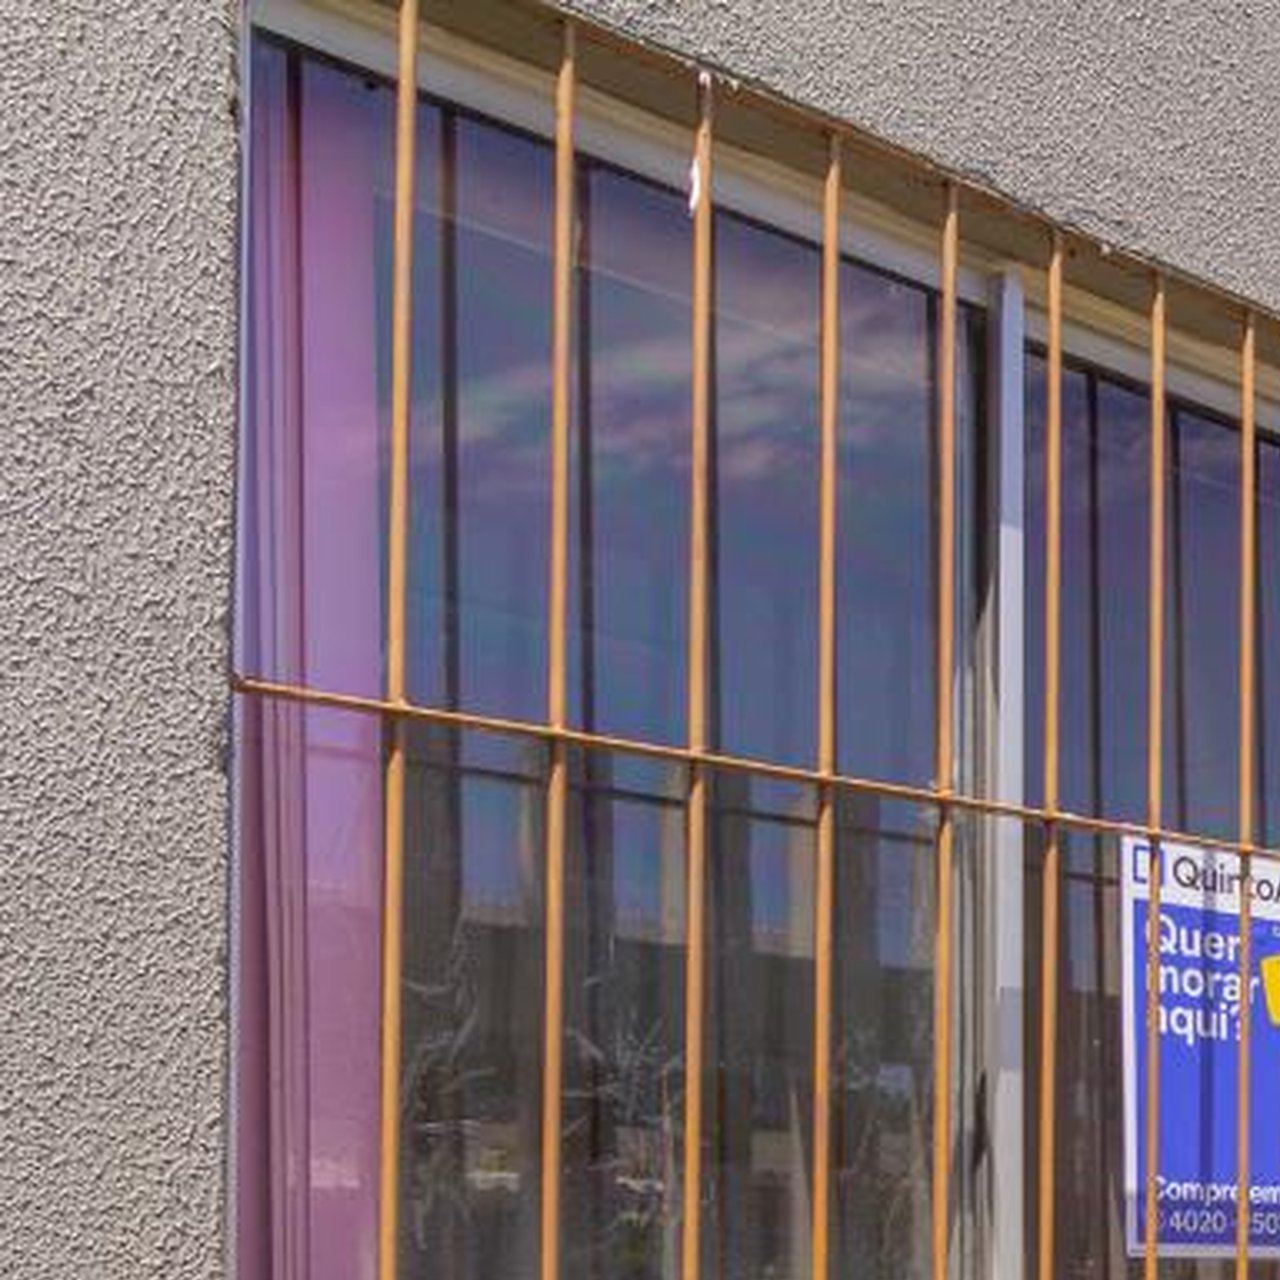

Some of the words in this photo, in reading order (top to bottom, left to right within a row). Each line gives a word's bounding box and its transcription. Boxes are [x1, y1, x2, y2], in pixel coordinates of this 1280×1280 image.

[1146, 914, 1241, 961] Quer
[1146, 965, 1260, 1004] morar
[1169, 1208, 1227, 1234] 4020
